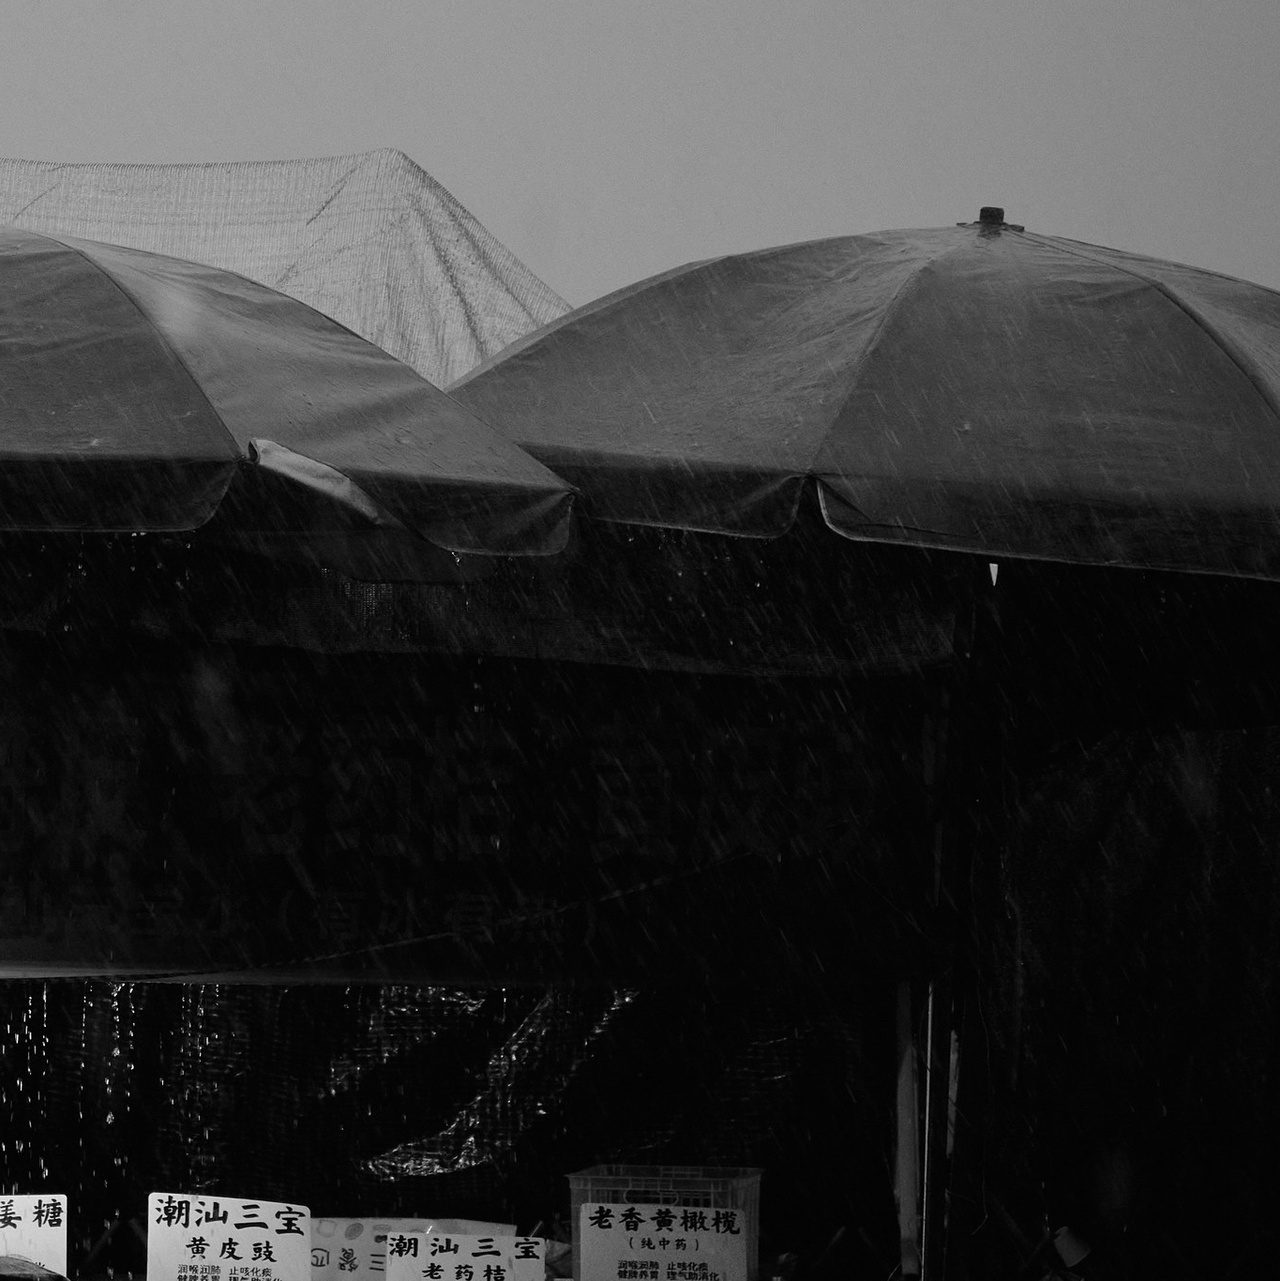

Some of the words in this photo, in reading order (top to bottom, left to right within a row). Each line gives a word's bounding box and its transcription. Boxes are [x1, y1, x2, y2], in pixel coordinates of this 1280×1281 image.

[155, 1195, 306, 1236] 潮汕三宝
[589, 1206, 741, 1235] 老香黄橄榄
[186, 1236, 277, 1262] 黄皮豉
[389, 1235, 541, 1260] 潮汕三宝
[422, 1263, 507, 1281] 老药桔
